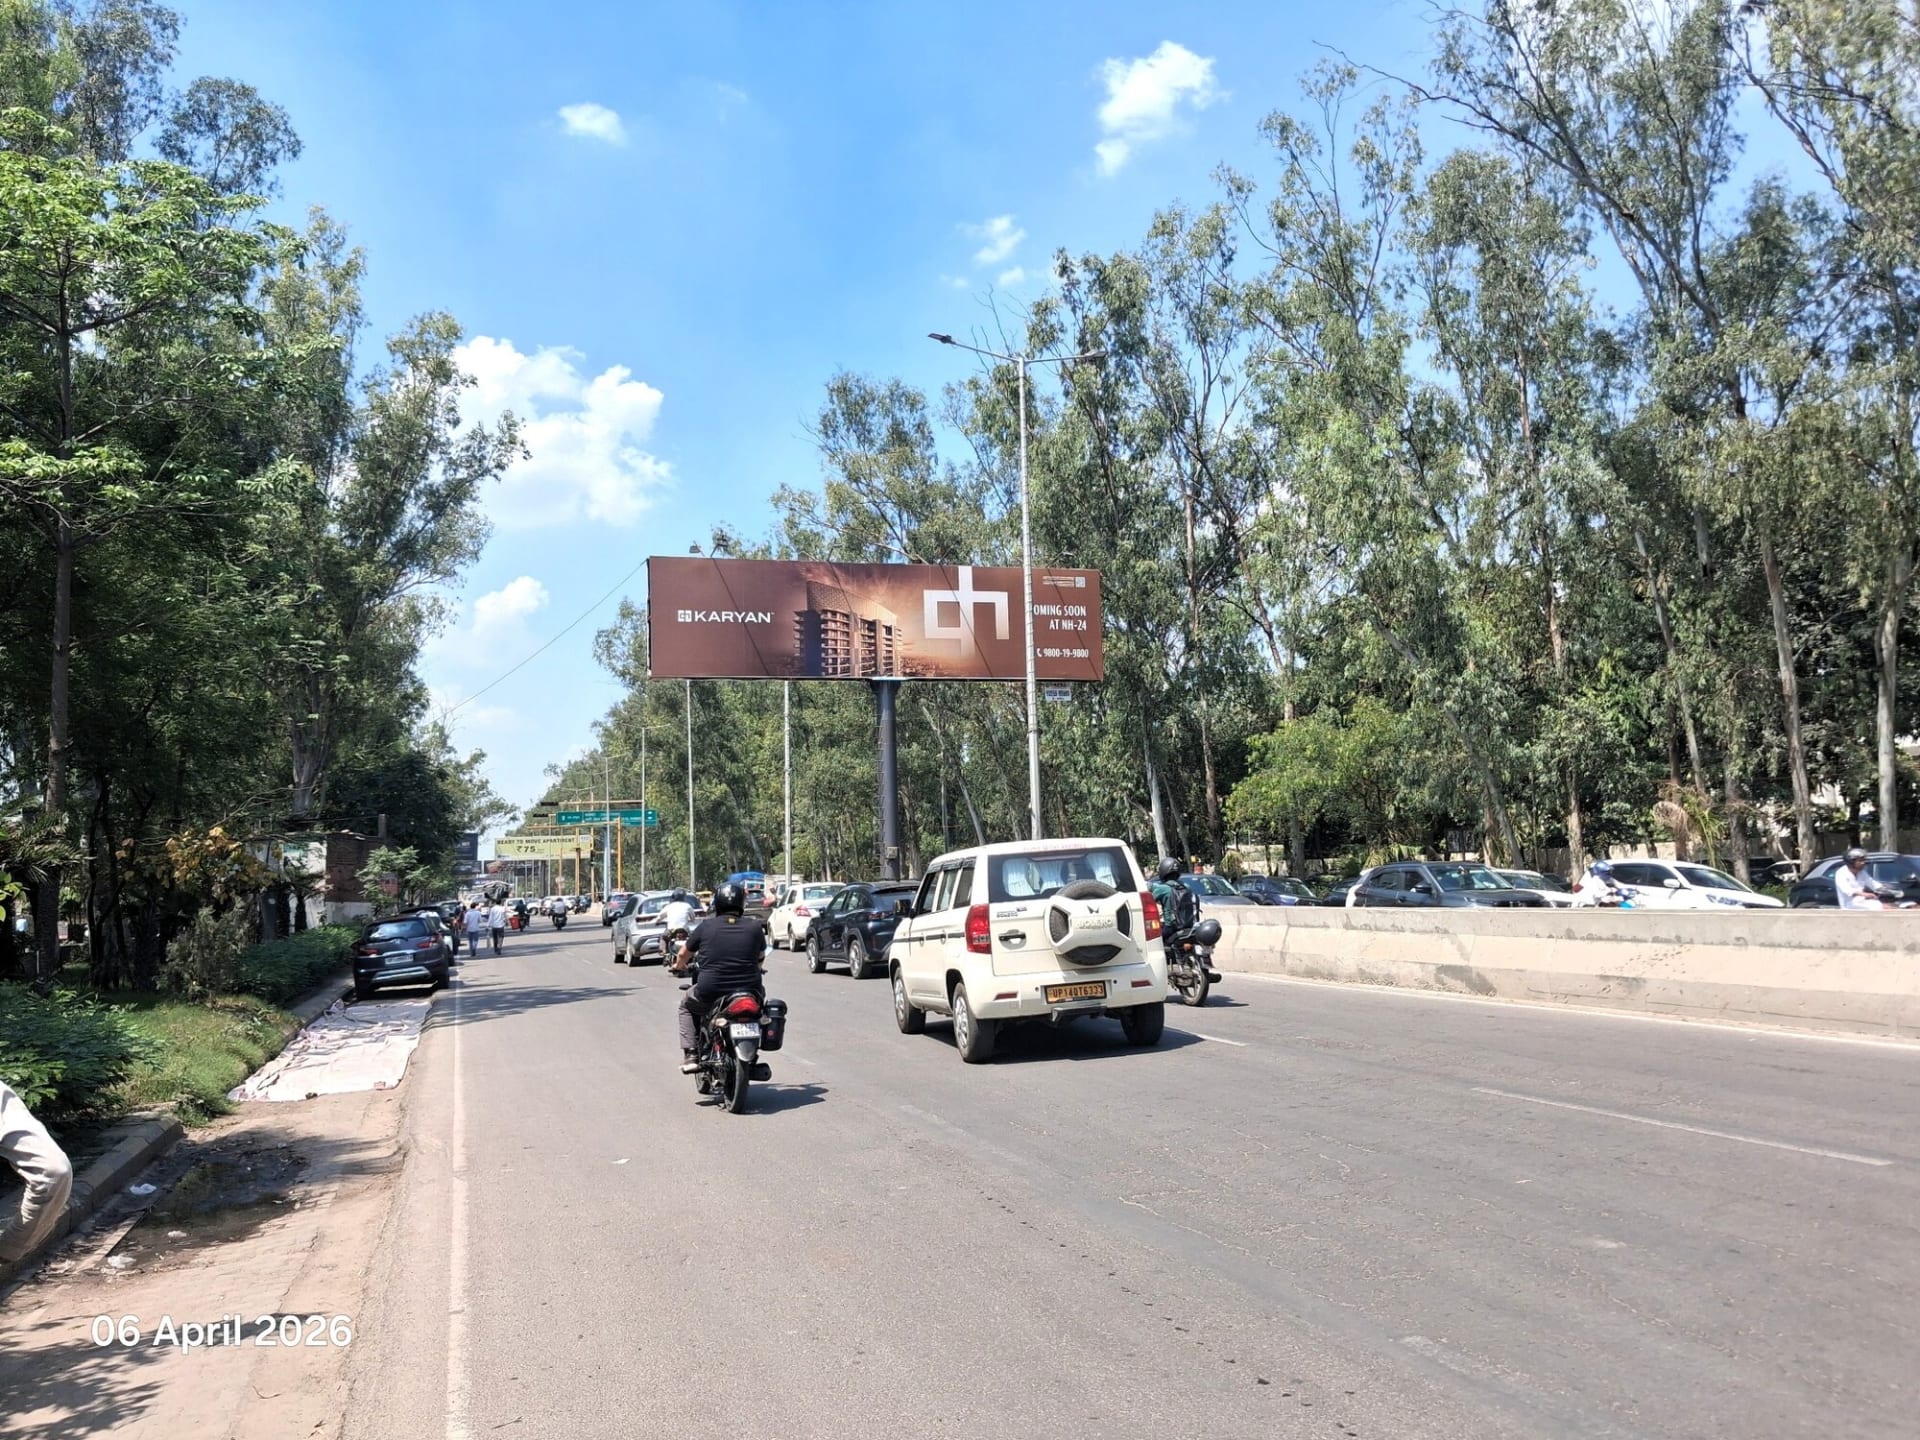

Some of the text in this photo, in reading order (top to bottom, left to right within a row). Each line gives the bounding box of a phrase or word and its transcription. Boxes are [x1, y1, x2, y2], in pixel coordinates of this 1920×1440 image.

[1032, 604, 1087, 616] OMING SOON
[694, 610, 771, 623] KARYAN
[1049, 619, 1087, 631] AT NH-24
